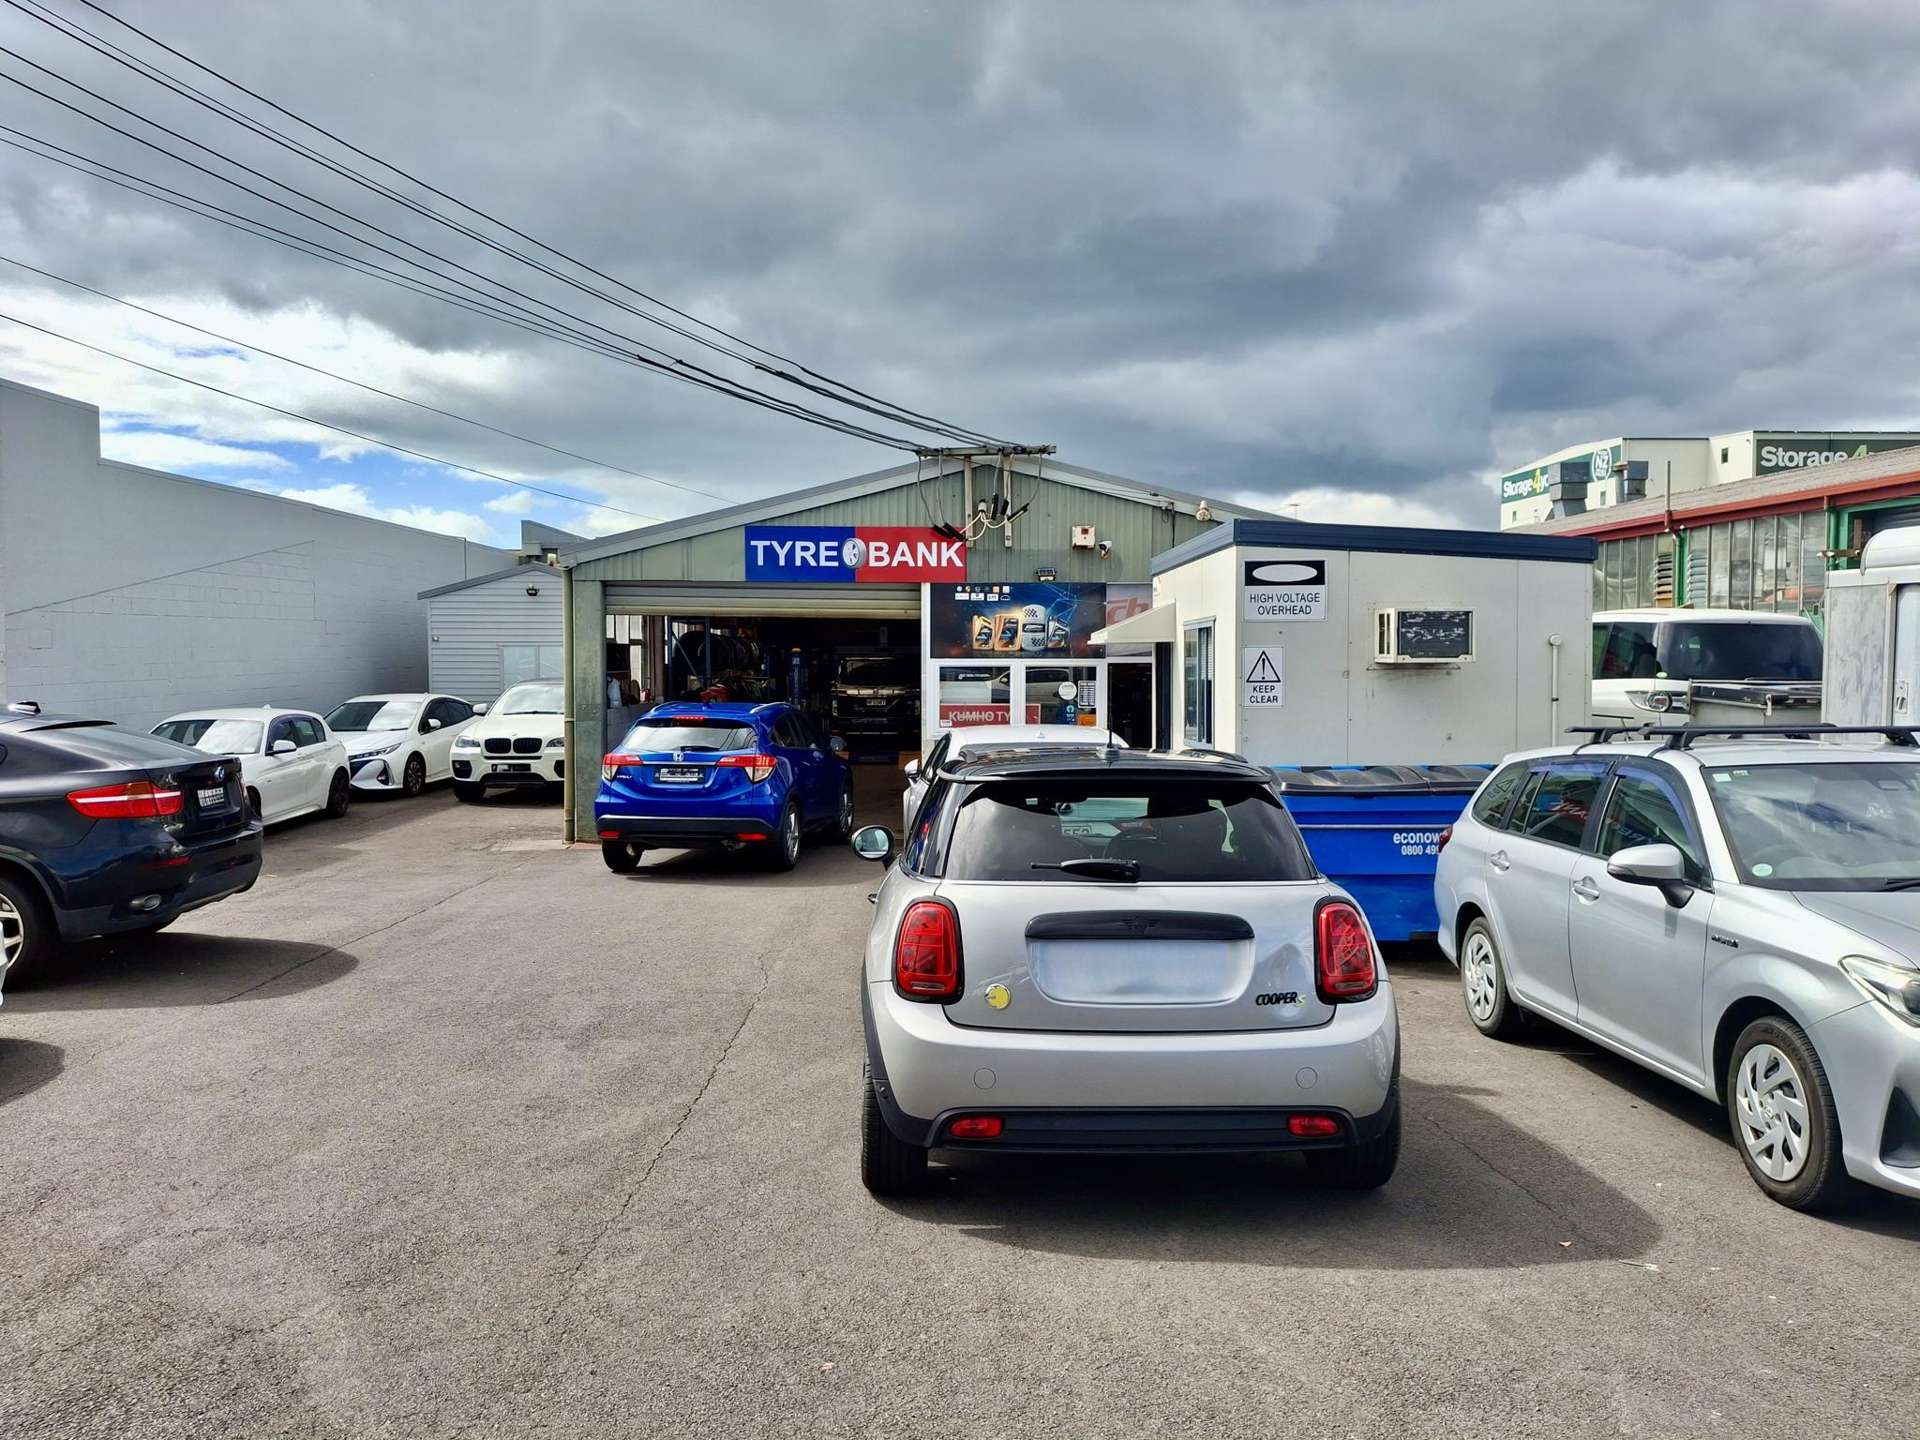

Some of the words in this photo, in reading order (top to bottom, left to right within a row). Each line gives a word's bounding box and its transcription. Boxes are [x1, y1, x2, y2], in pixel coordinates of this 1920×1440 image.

[1595, 454, 1609, 469] NZ
[750, 540, 839, 567] TYRE
[868, 541, 964, 568] BANK
[1250, 593, 1274, 603] HIGH
[1276, 592, 1320, 603] VOLTAGE
[1257, 605, 1312, 616] OVERHEAD
[1252, 685, 1275, 694] KEEP
[1249, 695, 1278, 704] CLEAR
[949, 711, 994, 722] KUMHO
[1401, 845, 1423, 856] 0800
[1255, 991, 1298, 1006] COOPER
